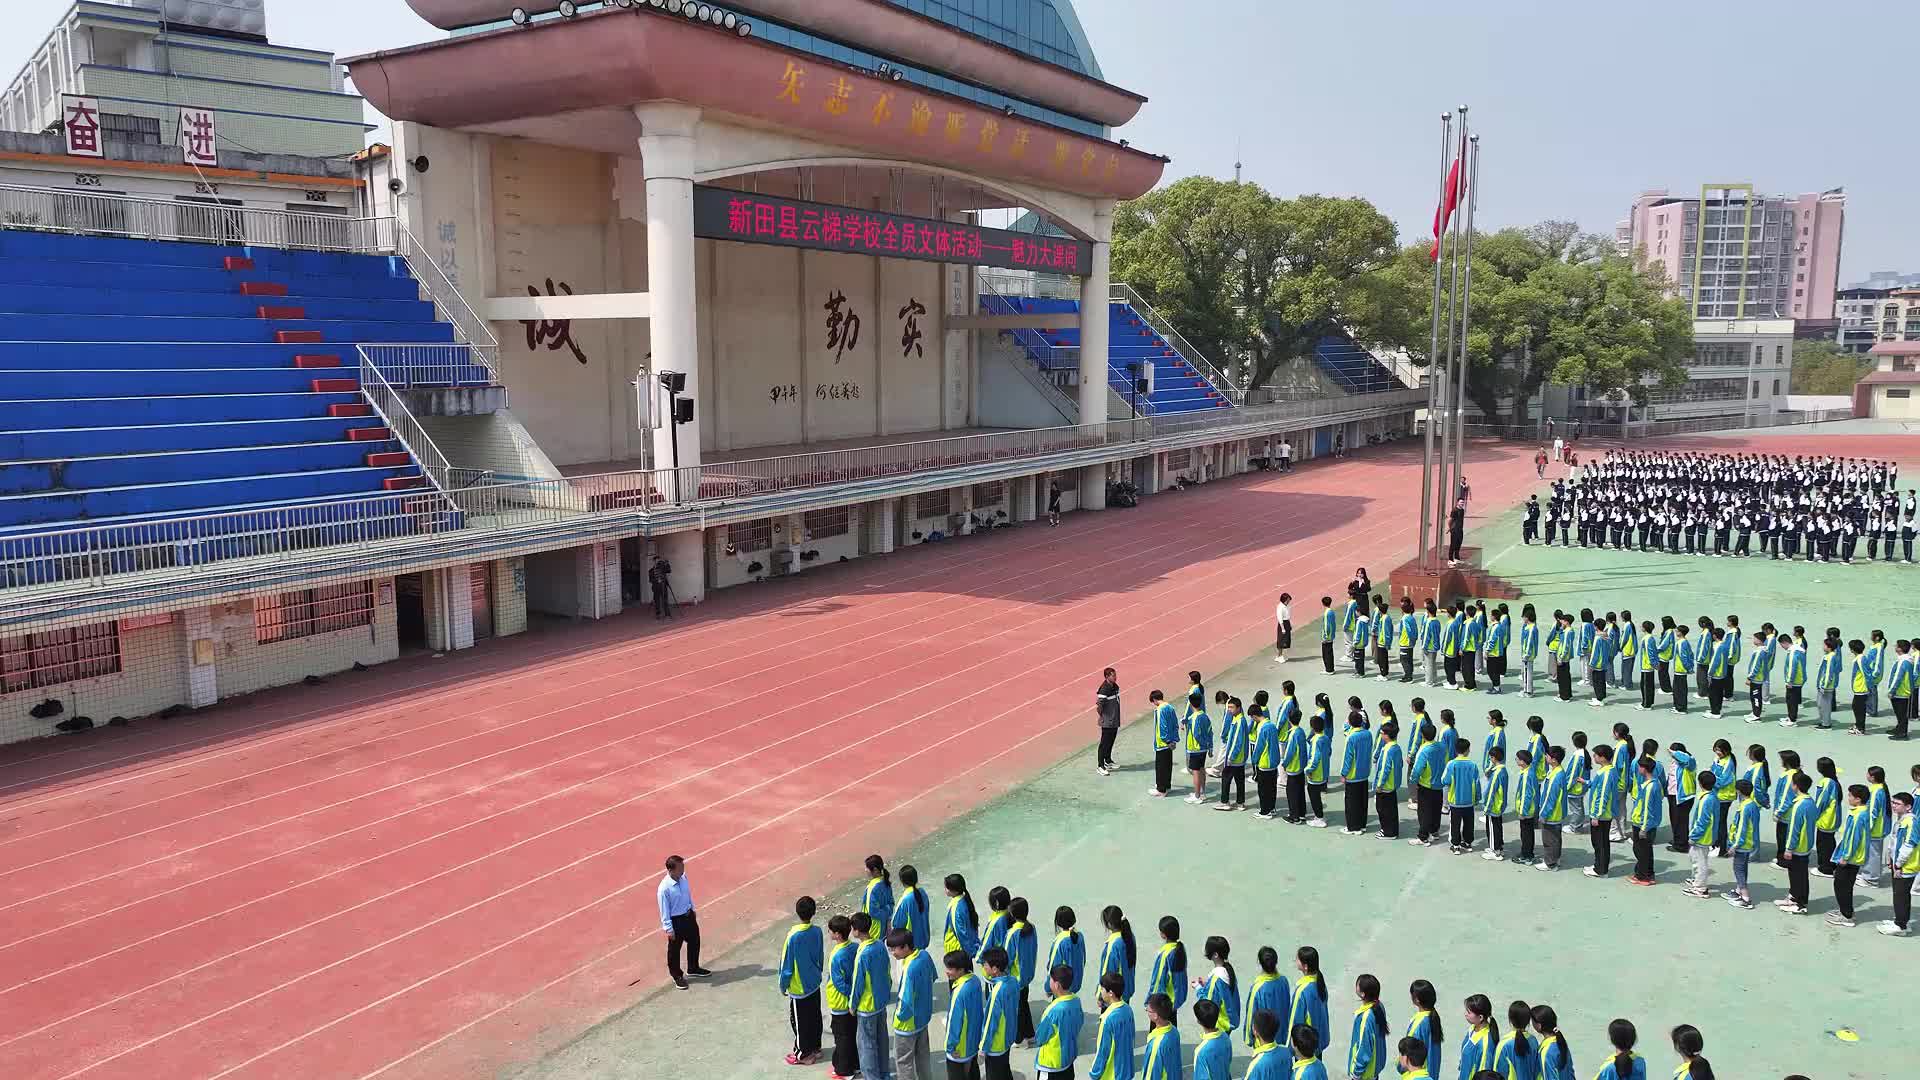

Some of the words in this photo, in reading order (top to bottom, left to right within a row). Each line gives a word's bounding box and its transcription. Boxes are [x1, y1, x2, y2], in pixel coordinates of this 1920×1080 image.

[66, 101, 98, 152] 奋
[183, 112, 215, 160] 进
[824, 289, 860, 365] 勤
[899, 297, 926, 359] 实
